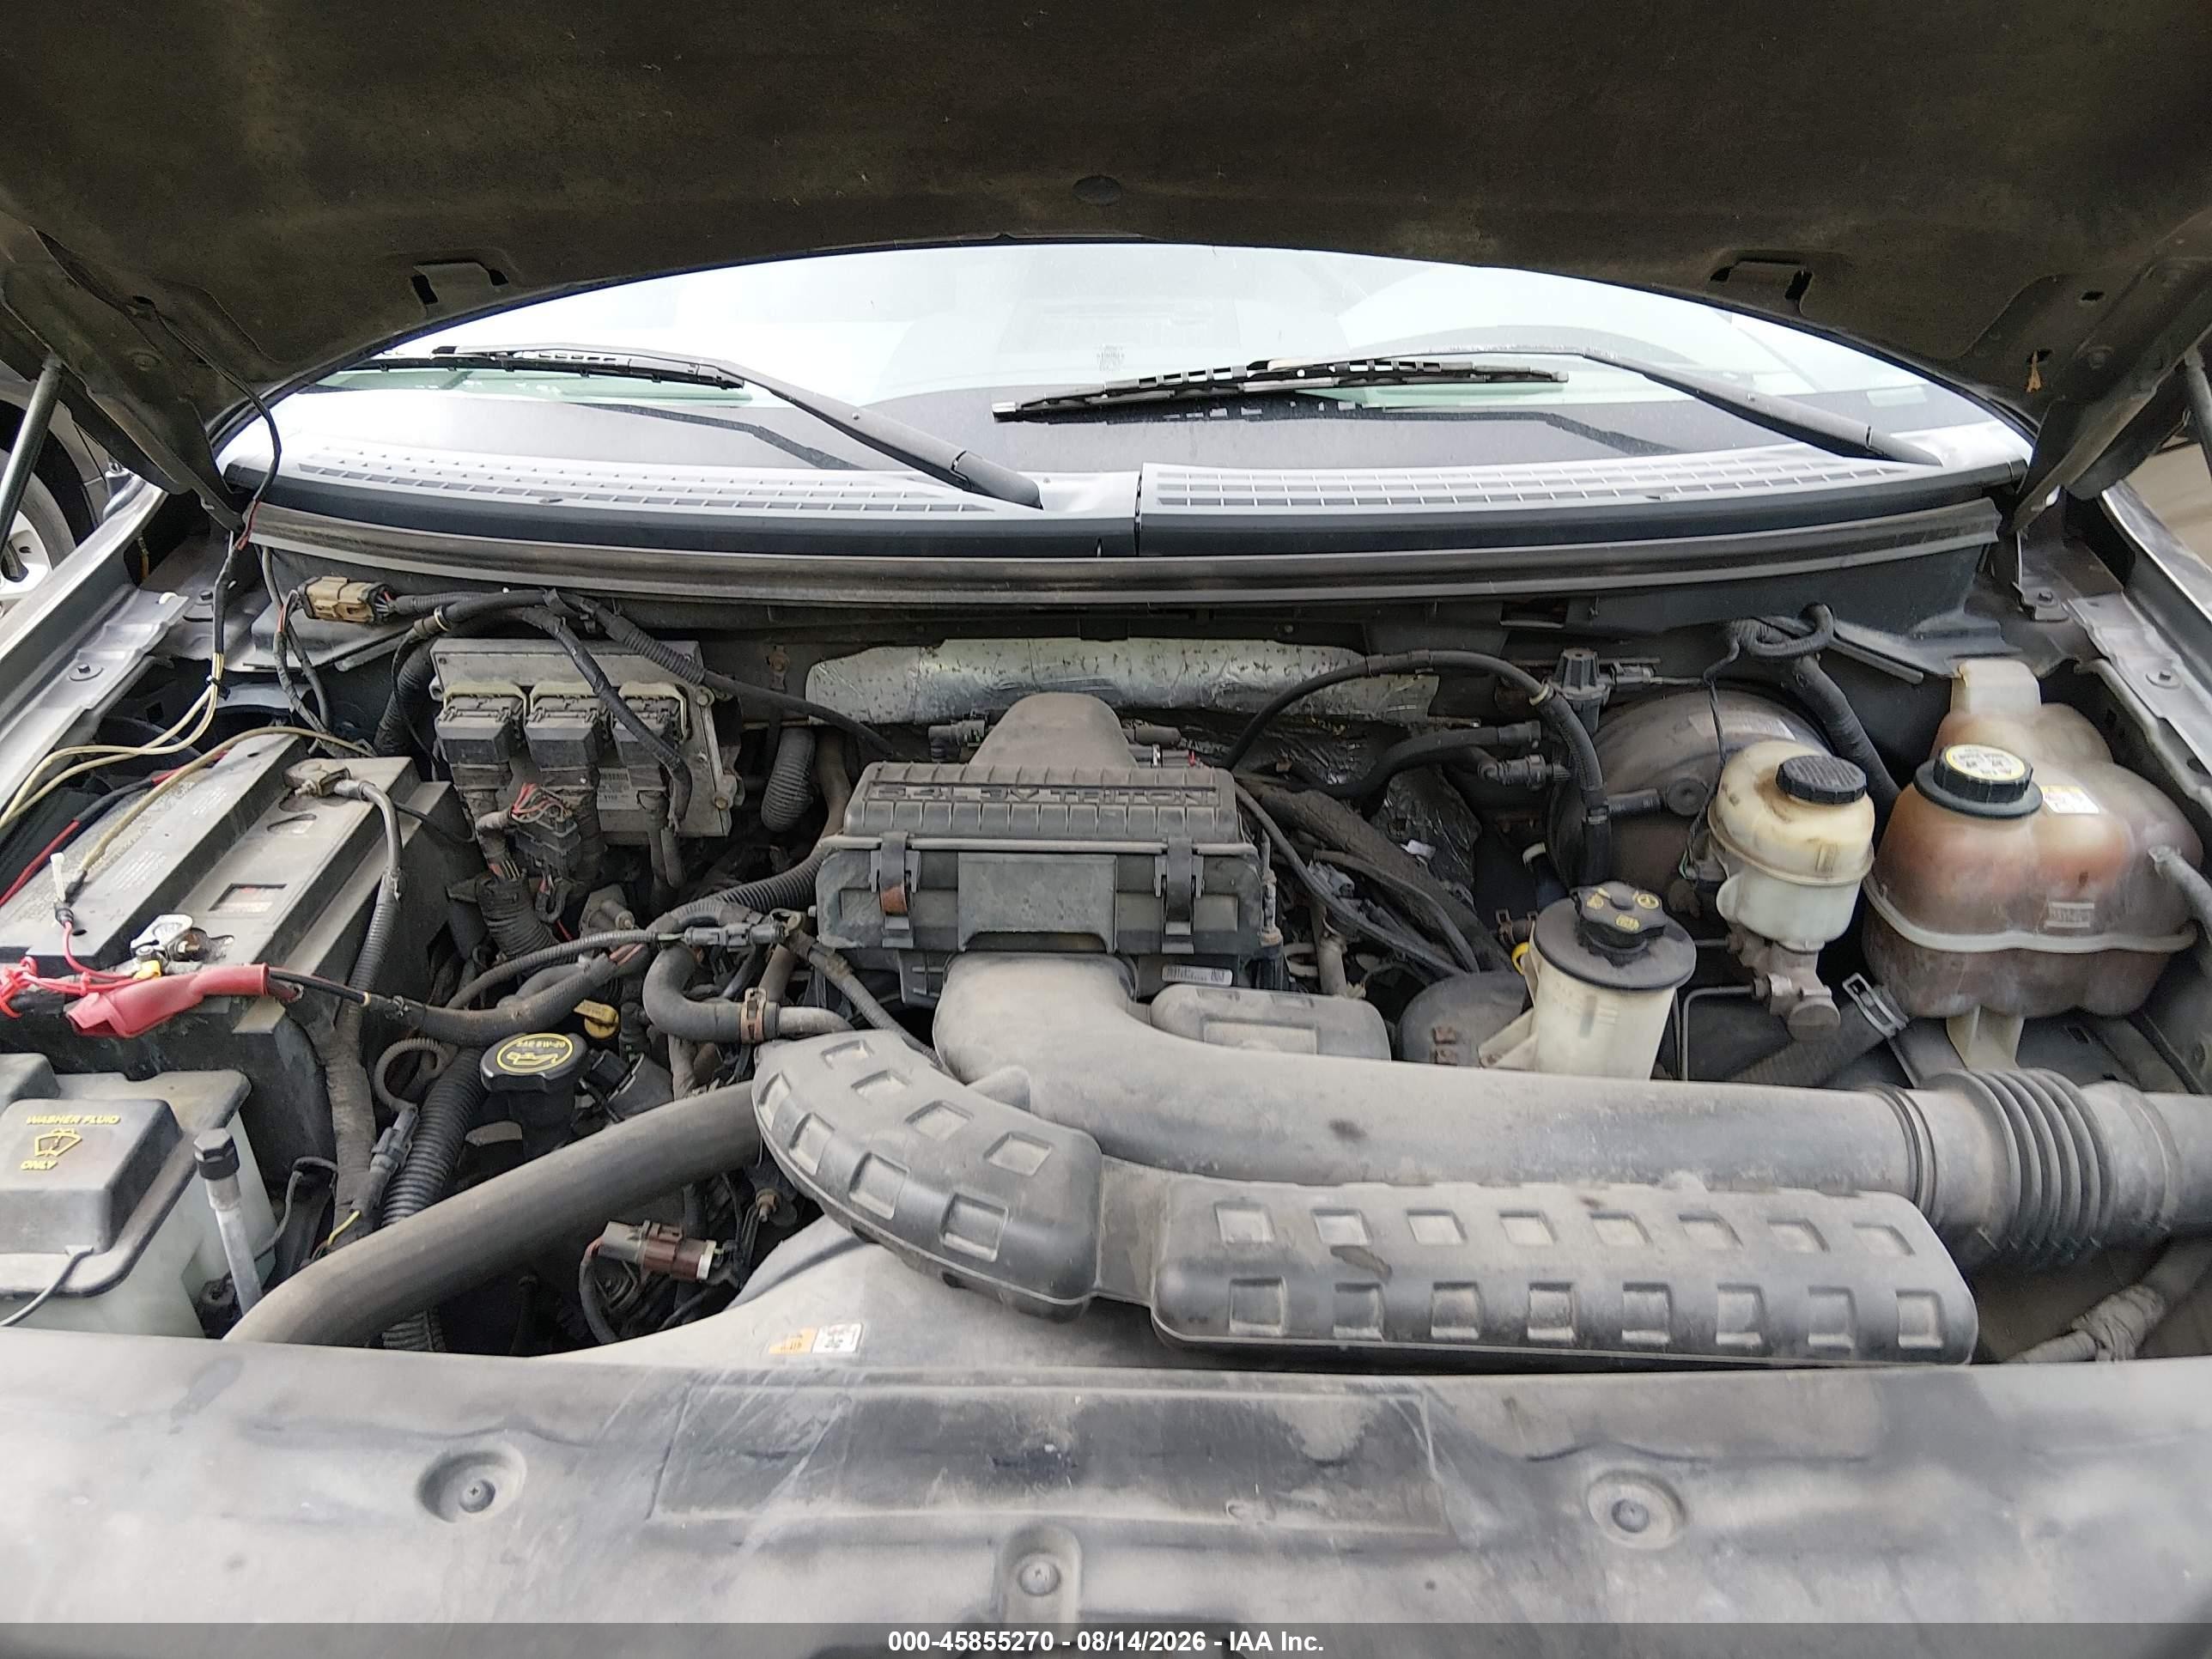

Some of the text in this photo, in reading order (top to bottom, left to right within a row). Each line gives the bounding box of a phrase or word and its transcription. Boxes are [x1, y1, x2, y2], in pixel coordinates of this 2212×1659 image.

[1050, 786, 1213, 805] TRITON
[26, 1115, 120, 1125] WASHER FLUID
[21, 1160, 58, 1170] ONLY
